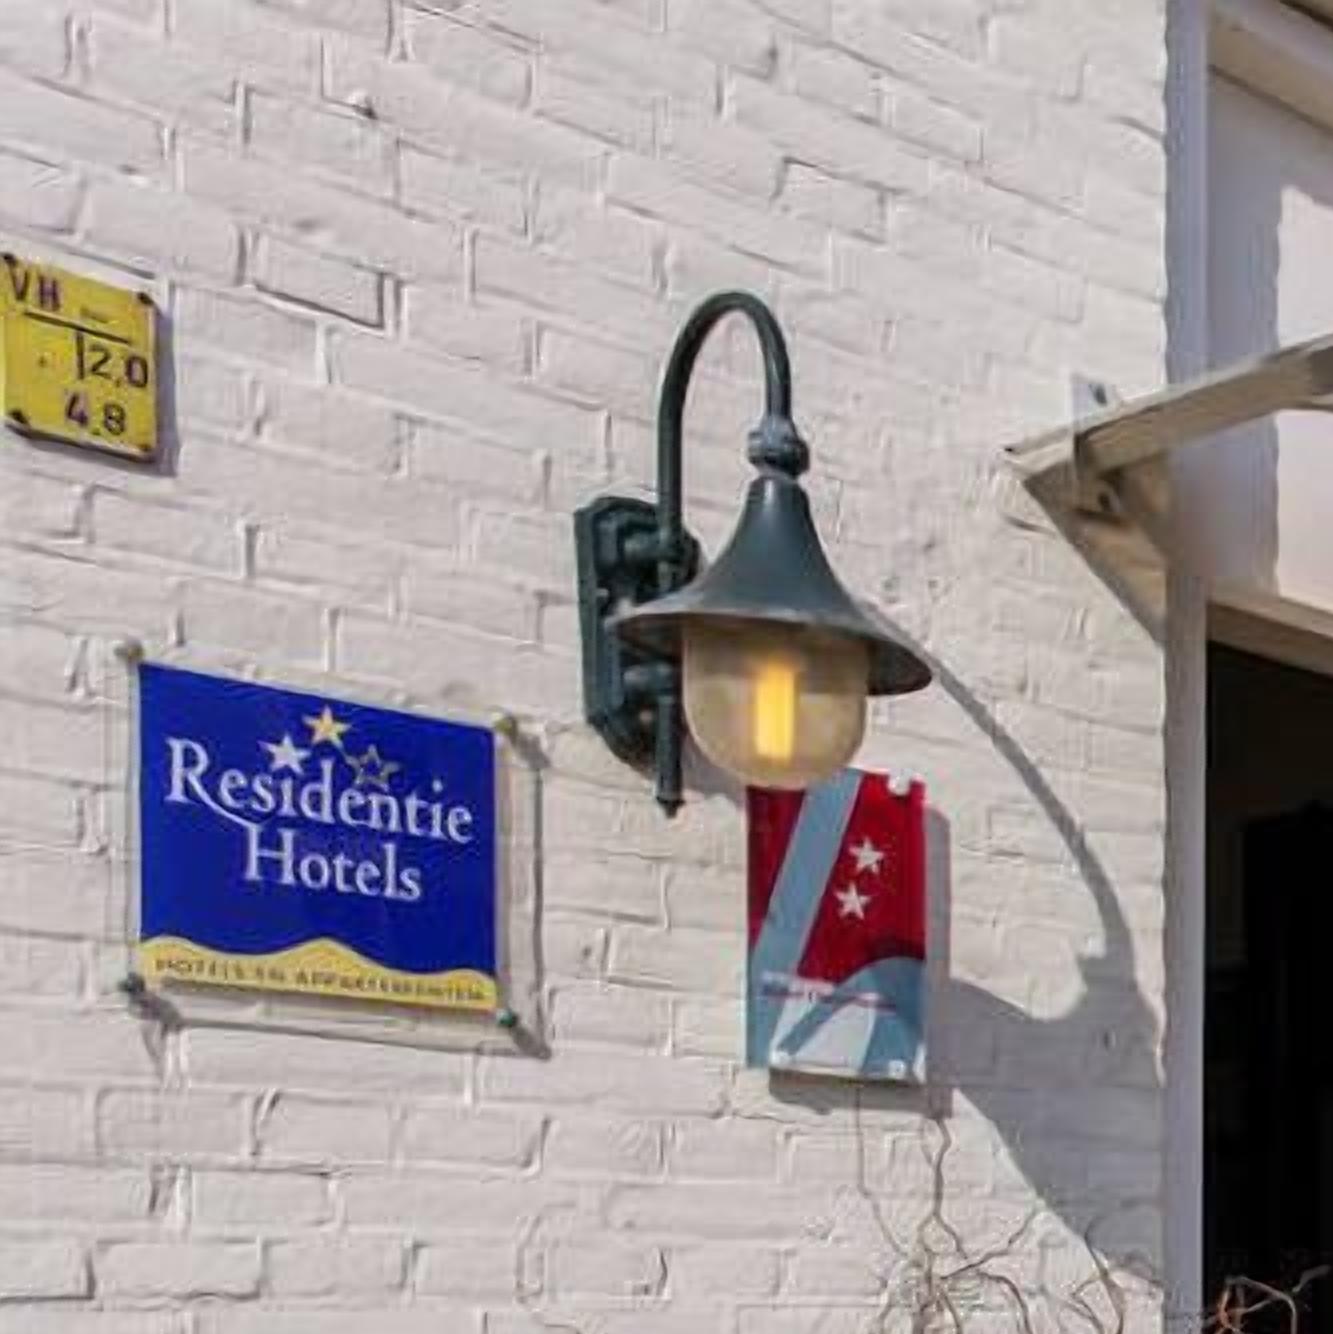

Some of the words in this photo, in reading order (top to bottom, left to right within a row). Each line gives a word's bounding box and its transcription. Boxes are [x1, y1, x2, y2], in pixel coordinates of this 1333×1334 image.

[9, 267, 61, 312] VH
[164, 736, 474, 844] Residentie
[245, 822, 422, 901] Hotels
